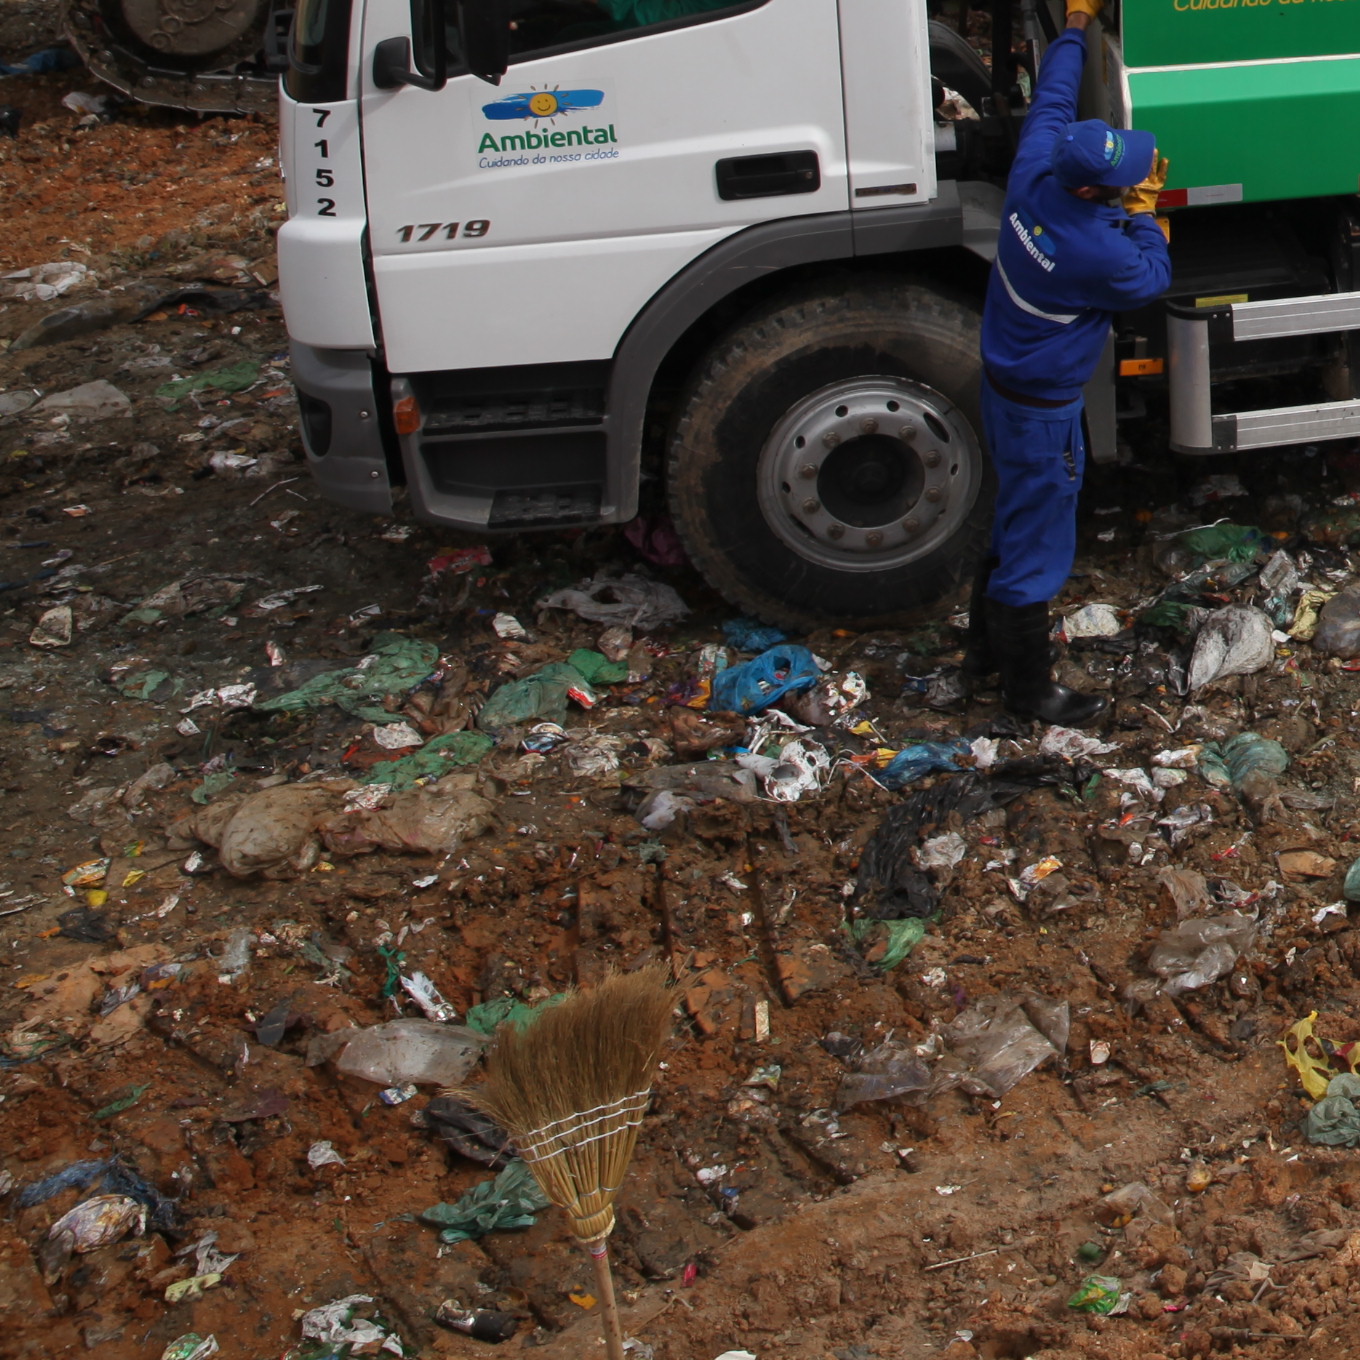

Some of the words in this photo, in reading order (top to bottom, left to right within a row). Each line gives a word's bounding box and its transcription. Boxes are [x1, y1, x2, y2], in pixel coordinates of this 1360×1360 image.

[478, 123, 618, 154] Ambiental
[478, 155, 530, 169] Cuidando
[532, 153, 547, 165] da
[549, 152, 582, 163] nossa
[584, 147, 620, 161] cidade
[396, 219, 491, 244] 1719
[1009, 212, 1056, 273] Ambiental
